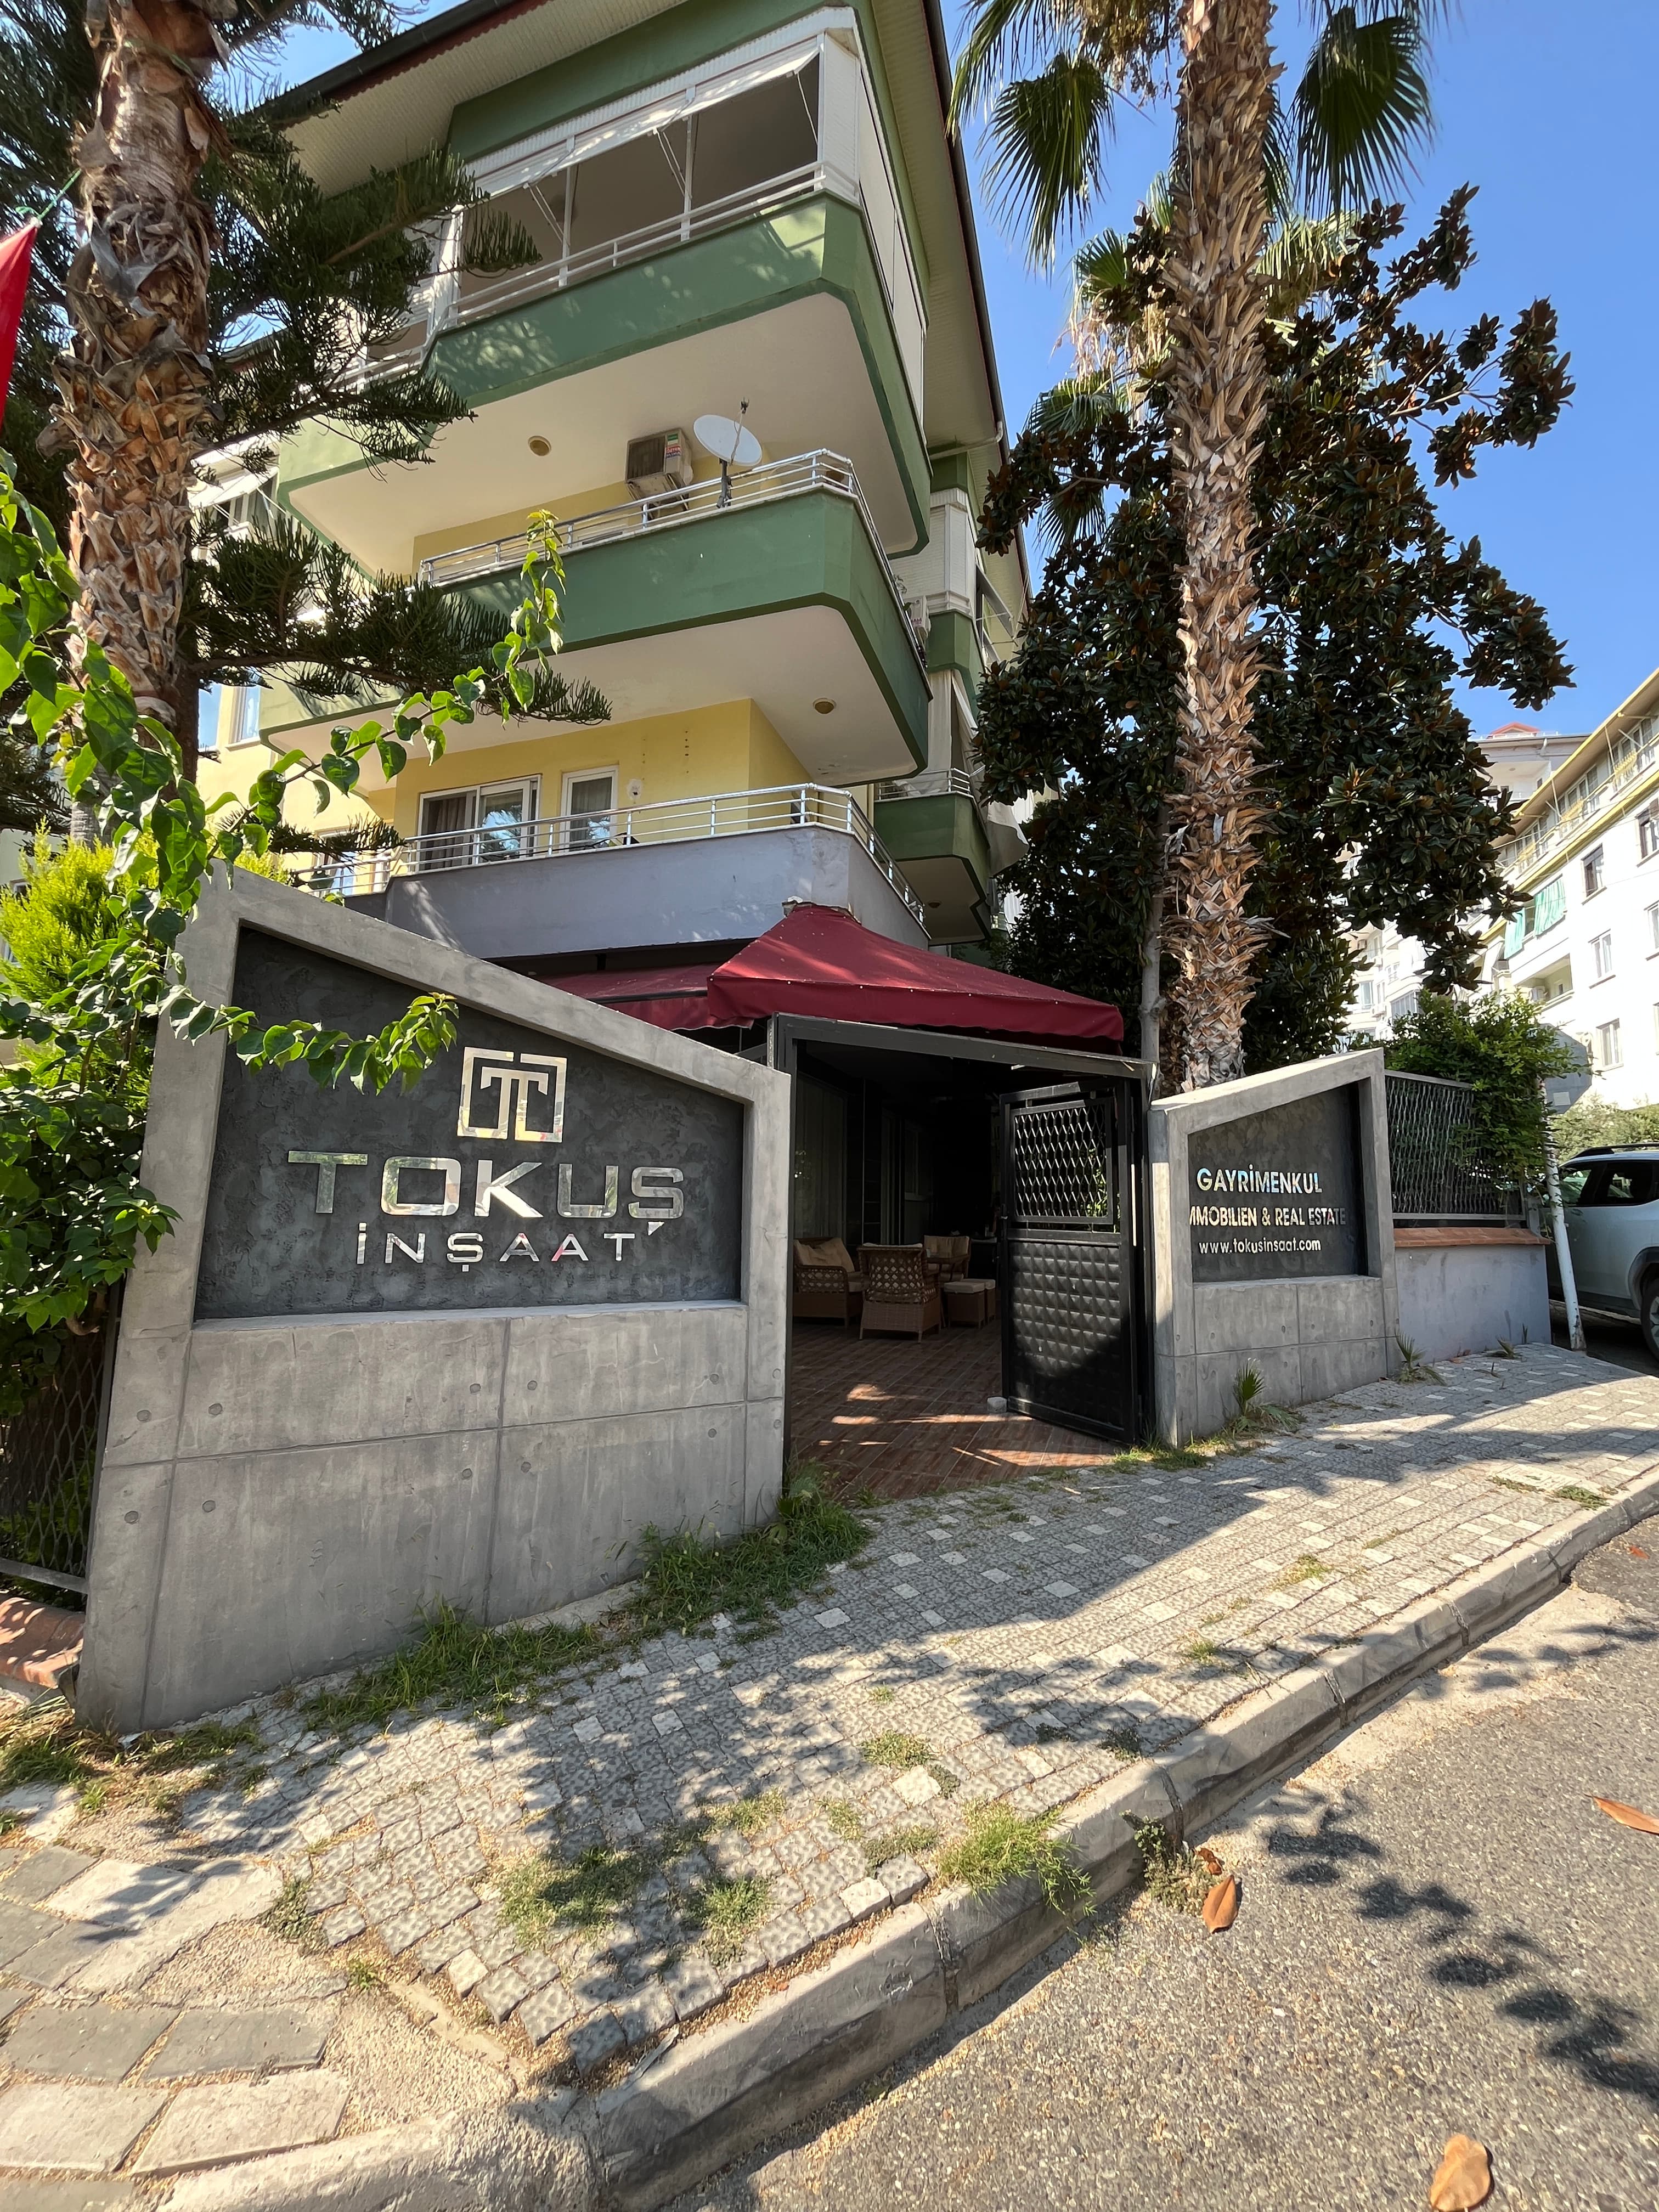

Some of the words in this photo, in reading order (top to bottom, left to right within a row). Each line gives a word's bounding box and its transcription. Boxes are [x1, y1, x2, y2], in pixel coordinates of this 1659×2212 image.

[288, 1150, 684, 1236] TOKUŞ
[1197, 1164, 1323, 1194] GAYRİMENKUL
[1262, 1206, 1271, 1226] &
[1276, 1206, 1306, 1226] REAL
[1308, 1207, 1346, 1226] ESTATE
[357, 1222, 635, 1272] İNŞAAT
[1199, 1237, 1322, 1254] www.tokusinsaat.com
